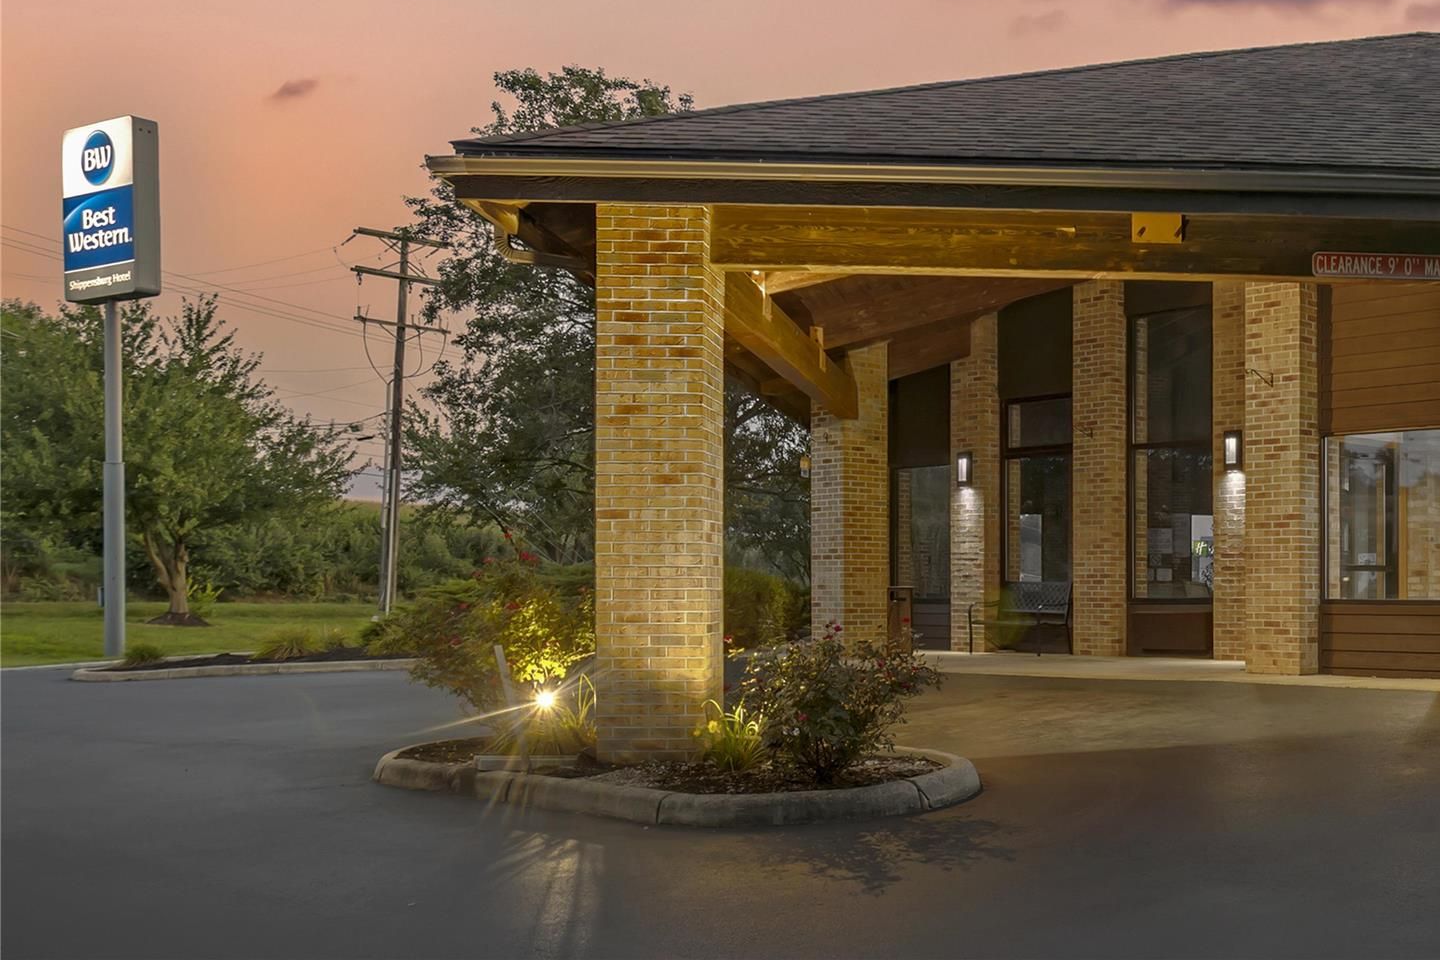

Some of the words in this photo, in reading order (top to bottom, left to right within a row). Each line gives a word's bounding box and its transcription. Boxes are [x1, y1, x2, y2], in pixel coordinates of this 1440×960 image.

[83, 144, 112, 172] BW
[82, 206, 116, 230] Best
[1316, 255, 1383, 274] CLEARANCE
[112, 270, 131, 284] Hotel
